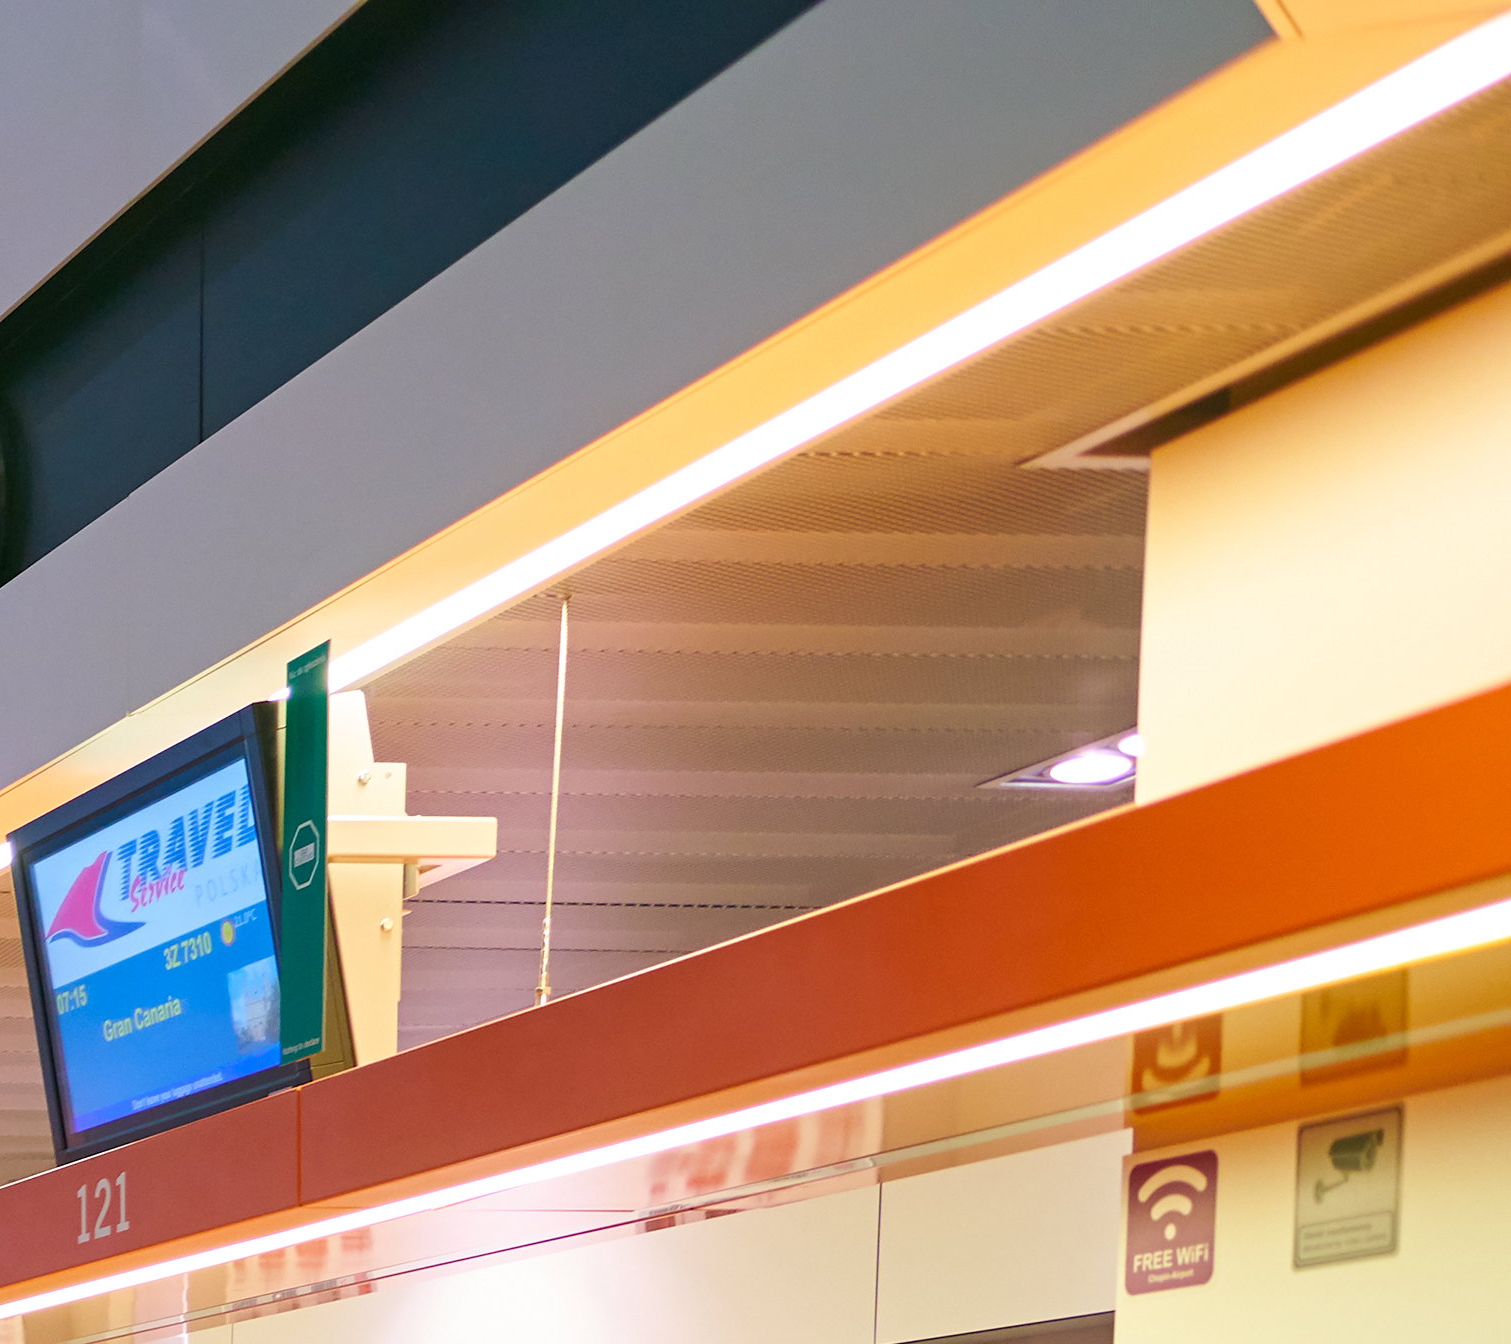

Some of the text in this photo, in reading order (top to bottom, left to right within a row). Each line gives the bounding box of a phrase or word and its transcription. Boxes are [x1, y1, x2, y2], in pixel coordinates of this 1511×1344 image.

[117, 783, 257, 901] TRAVEL
[130, 866, 186, 913] Service
[182, 931, 213, 964] 7310
[56, 983, 88, 1016] 07:15
[103, 995, 183, 1042] Gran Canaria
[77, 1171, 130, 1244] 121
[1133, 1242, 1210, 1274] FREE WiFi
